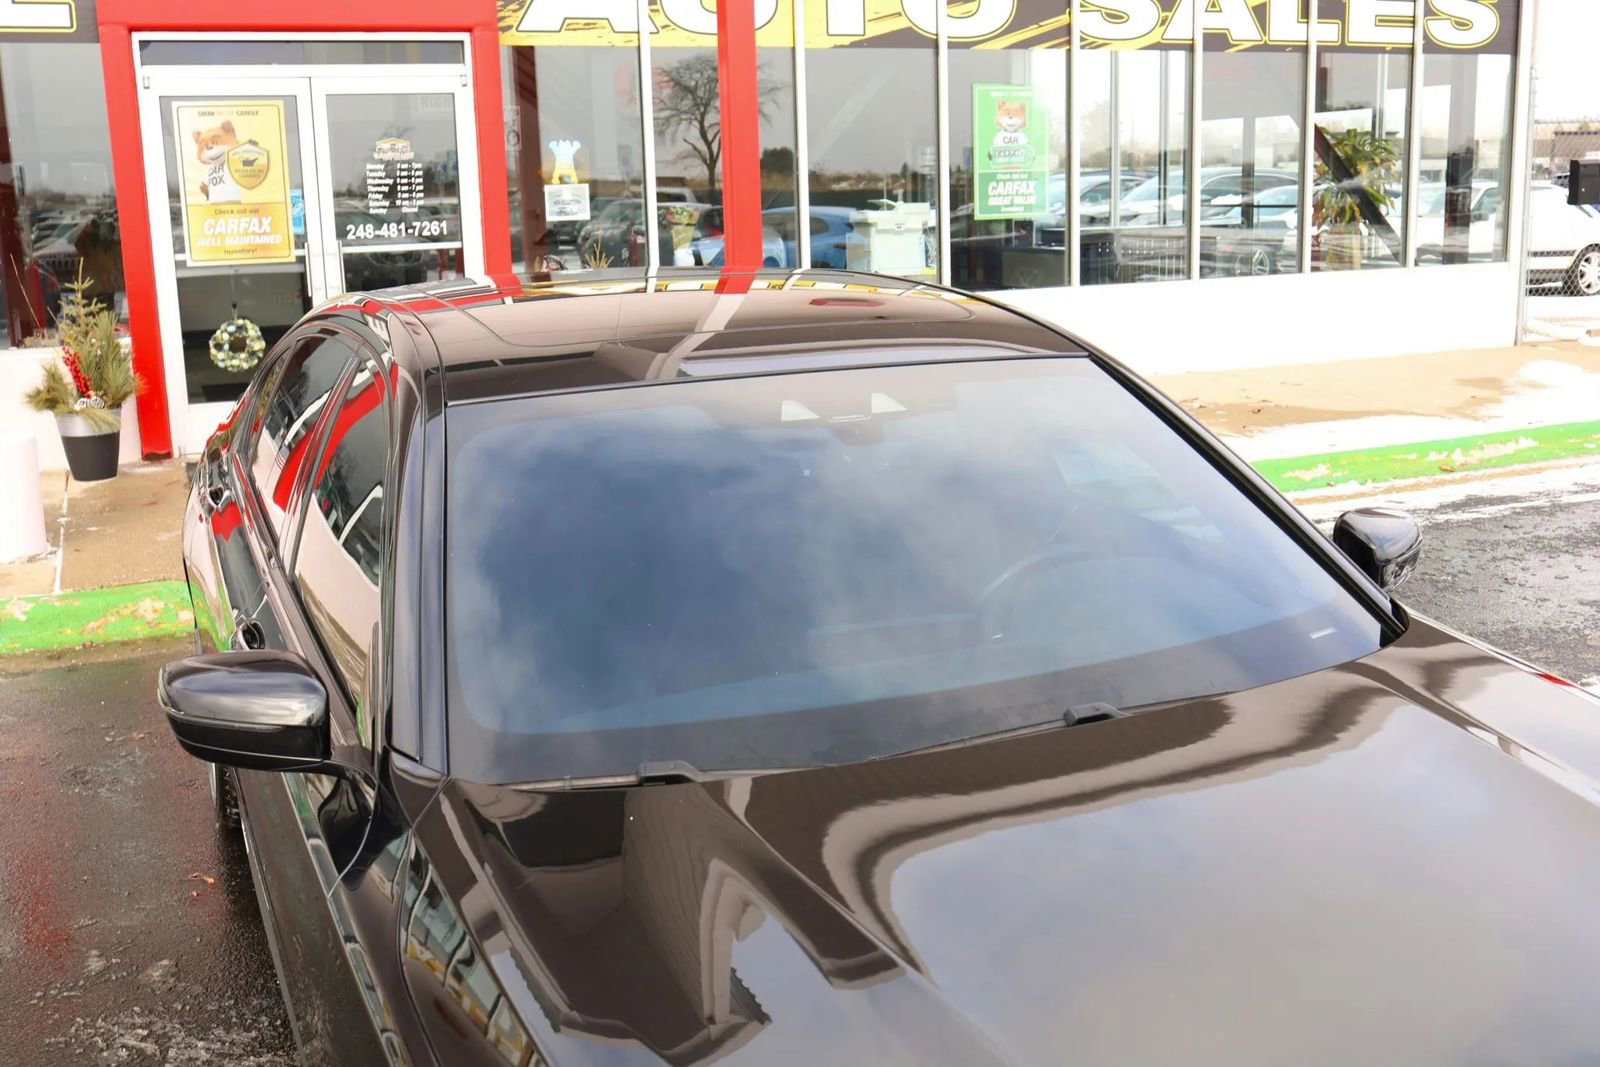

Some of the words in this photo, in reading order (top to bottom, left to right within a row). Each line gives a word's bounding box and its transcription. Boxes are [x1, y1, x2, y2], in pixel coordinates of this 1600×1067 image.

[988, 180, 1038, 196] CARFAX
[203, 215, 272, 235] CARFAX
[346, 220, 448, 240] 248-481-7261
[196, 237, 223, 247] WELL
[224, 234, 282, 245] MAINTAINED
